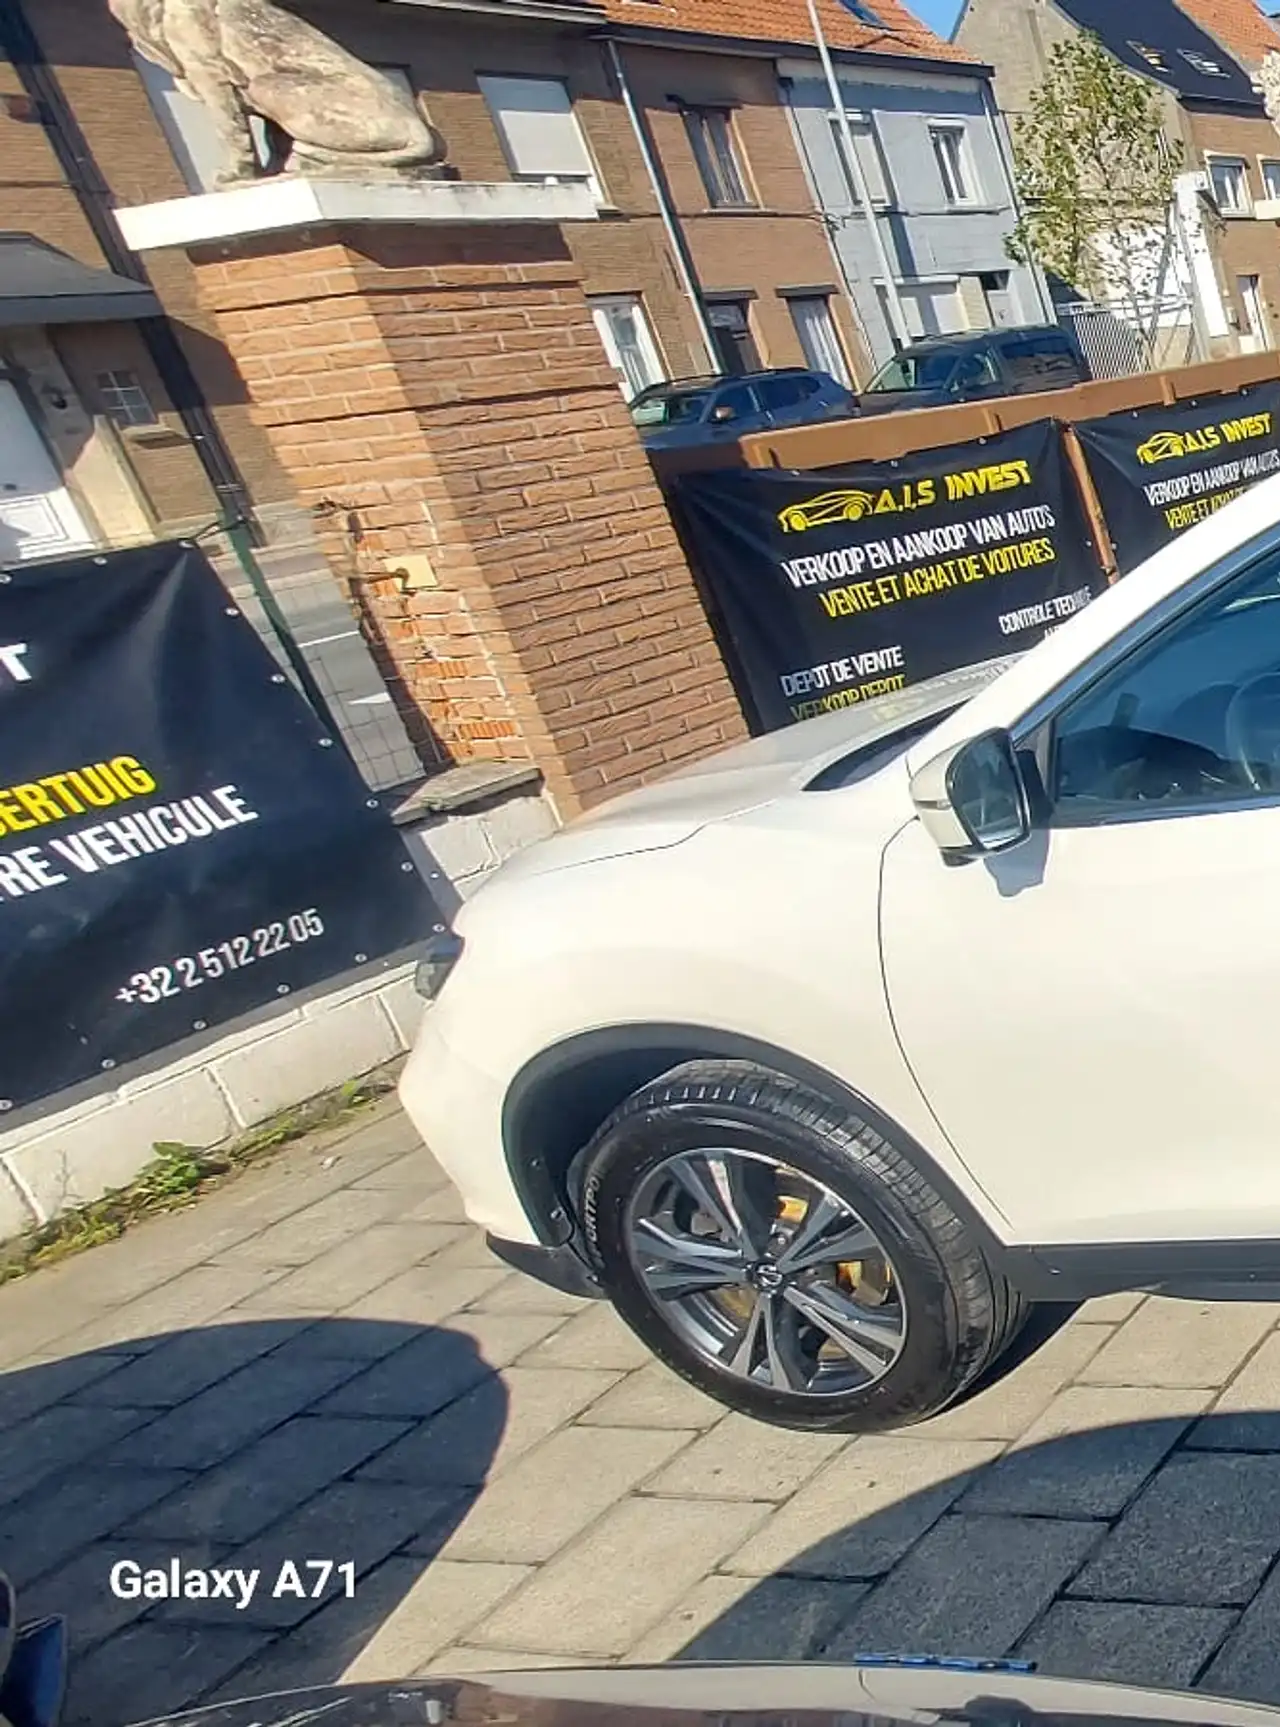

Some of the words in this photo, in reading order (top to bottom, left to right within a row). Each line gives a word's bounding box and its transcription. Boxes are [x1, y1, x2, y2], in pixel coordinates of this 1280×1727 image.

[1220, 413, 1272, 443] INVEST
[944, 460, 1032, 501] INVEST
[1164, 502, 1199, 530] VENTE
[781, 549, 866, 588] VERKOOP
[867, 543, 892, 570] EN
[894, 524, 969, 565] AANKOOP
[968, 513, 1009, 545] VAN
[1008, 504, 1057, 538] AUTO'S
[818, 580, 882, 618] VENTE
[877, 575, 902, 604] ET
[903, 560, 963, 598] ACHAT
[957, 555, 985, 583] DE
[982, 538, 1057, 574] VOITURES
[998, 608, 1056, 635] CONTROLE
[779, 665, 834, 698] DEPOT
[832, 659, 856, 682] DE
[850, 645, 906, 675] VENTE
[0, 755, 157, 838] ERTUIG
[49, 785, 259, 873] VEHICULE
[115, 966, 182, 1003] +32
